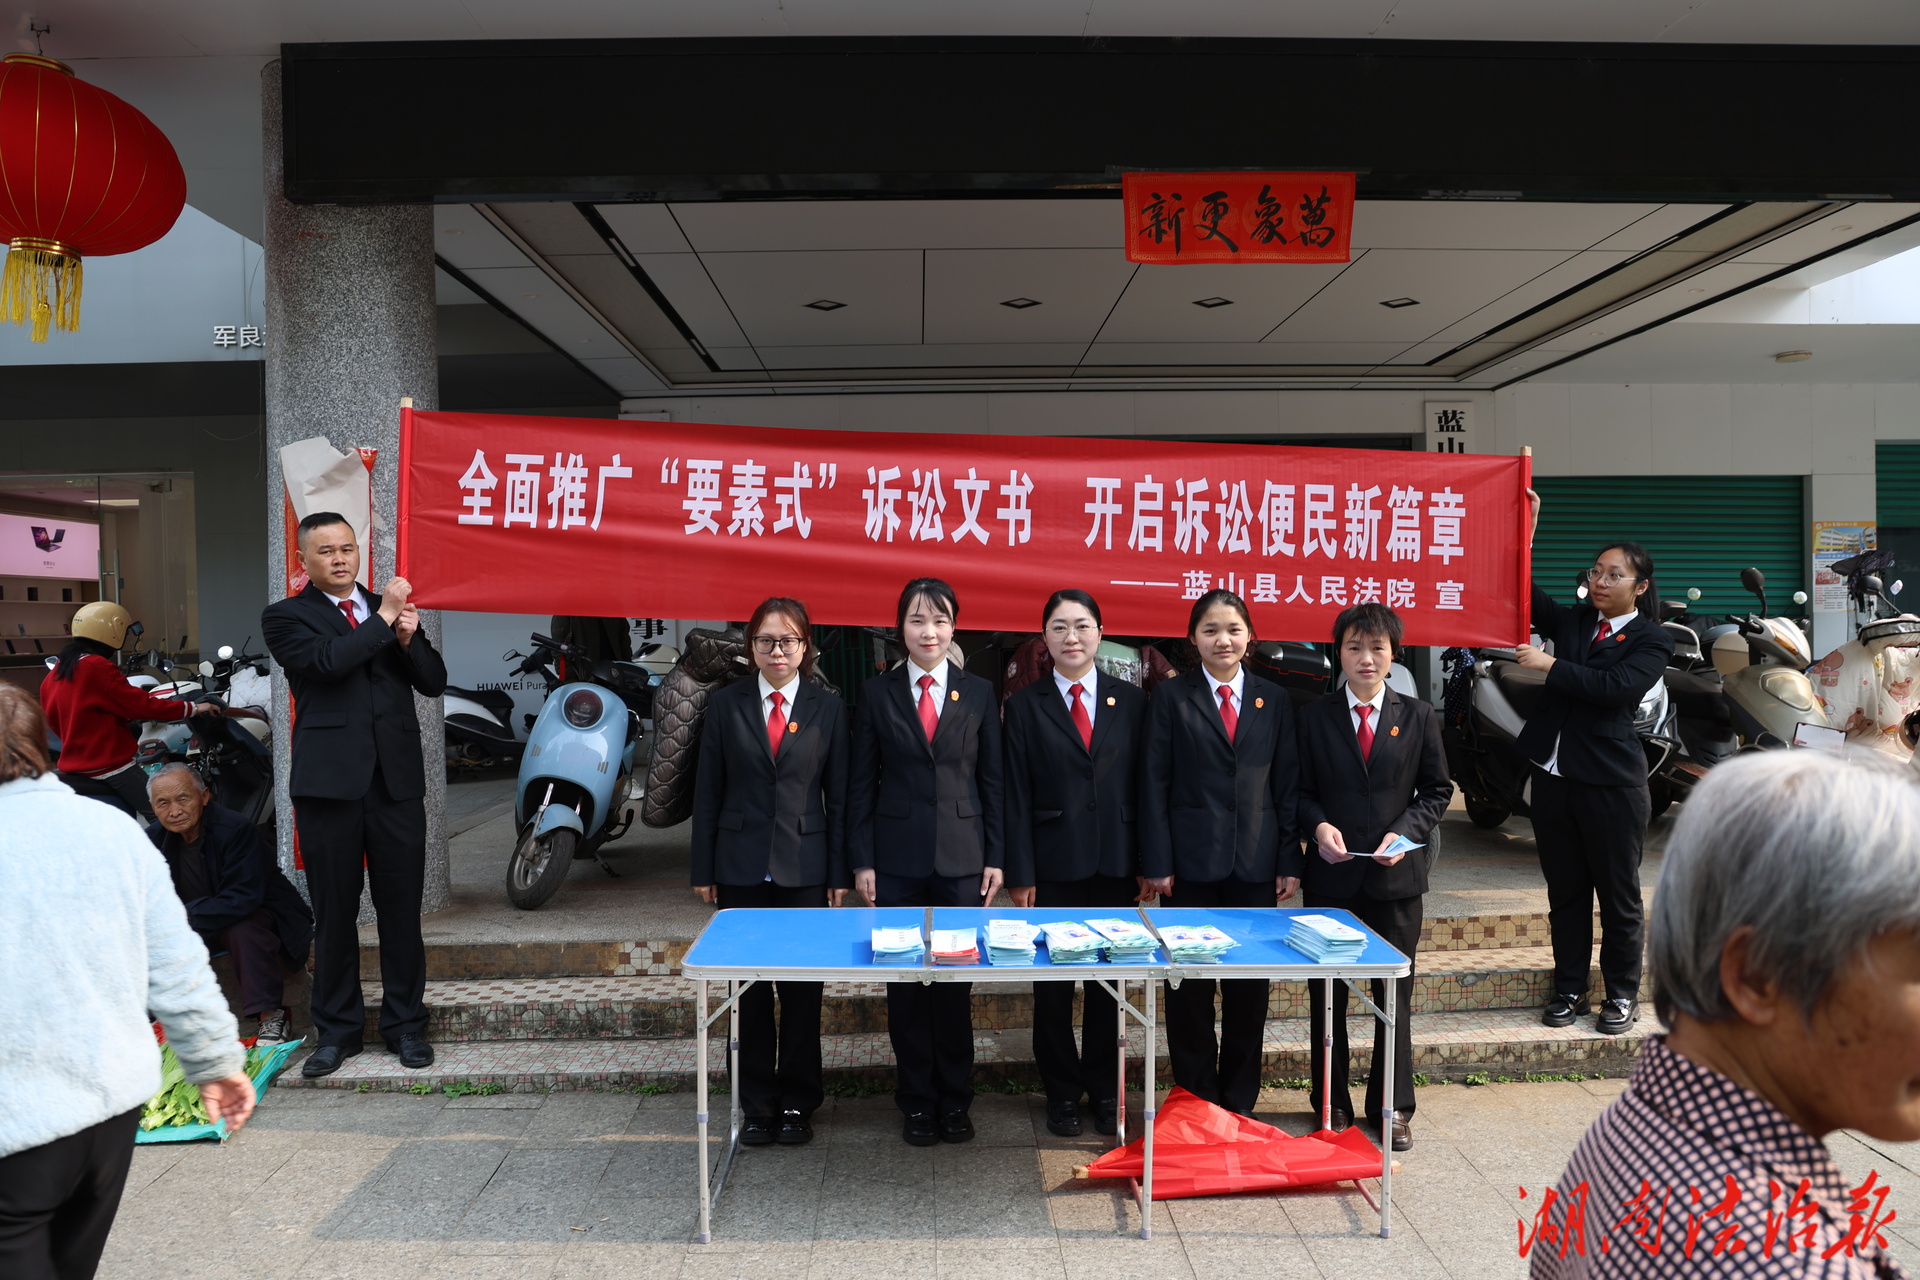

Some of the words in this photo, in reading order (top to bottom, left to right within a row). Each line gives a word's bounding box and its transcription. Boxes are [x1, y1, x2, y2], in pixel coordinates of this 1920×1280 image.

[213, 324, 266, 348] 军良
[1084, 473, 1467, 566] 开启诉讼便民新篇章
[1435, 579, 1465, 610] 宣
[476, 681, 523, 692] HUAWEI
